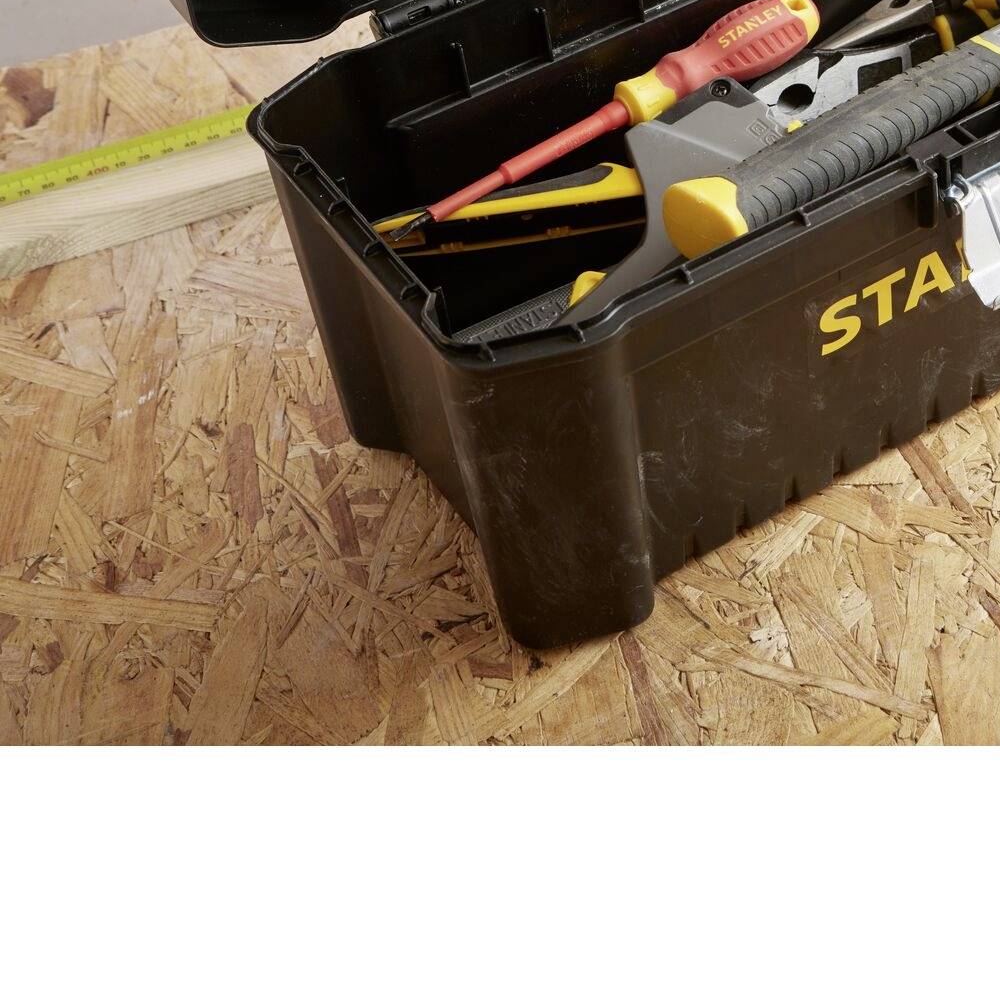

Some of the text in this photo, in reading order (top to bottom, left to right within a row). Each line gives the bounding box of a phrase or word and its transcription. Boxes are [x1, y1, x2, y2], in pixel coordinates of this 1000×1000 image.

[718, 4, 784, 49] STANLEY
[17, 189, 31, 197] 70
[86, 166, 110, 177] 400
[138, 154, 151, 162] 20
[162, 147, 174, 155] 30
[184, 140, 198, 148] 40
